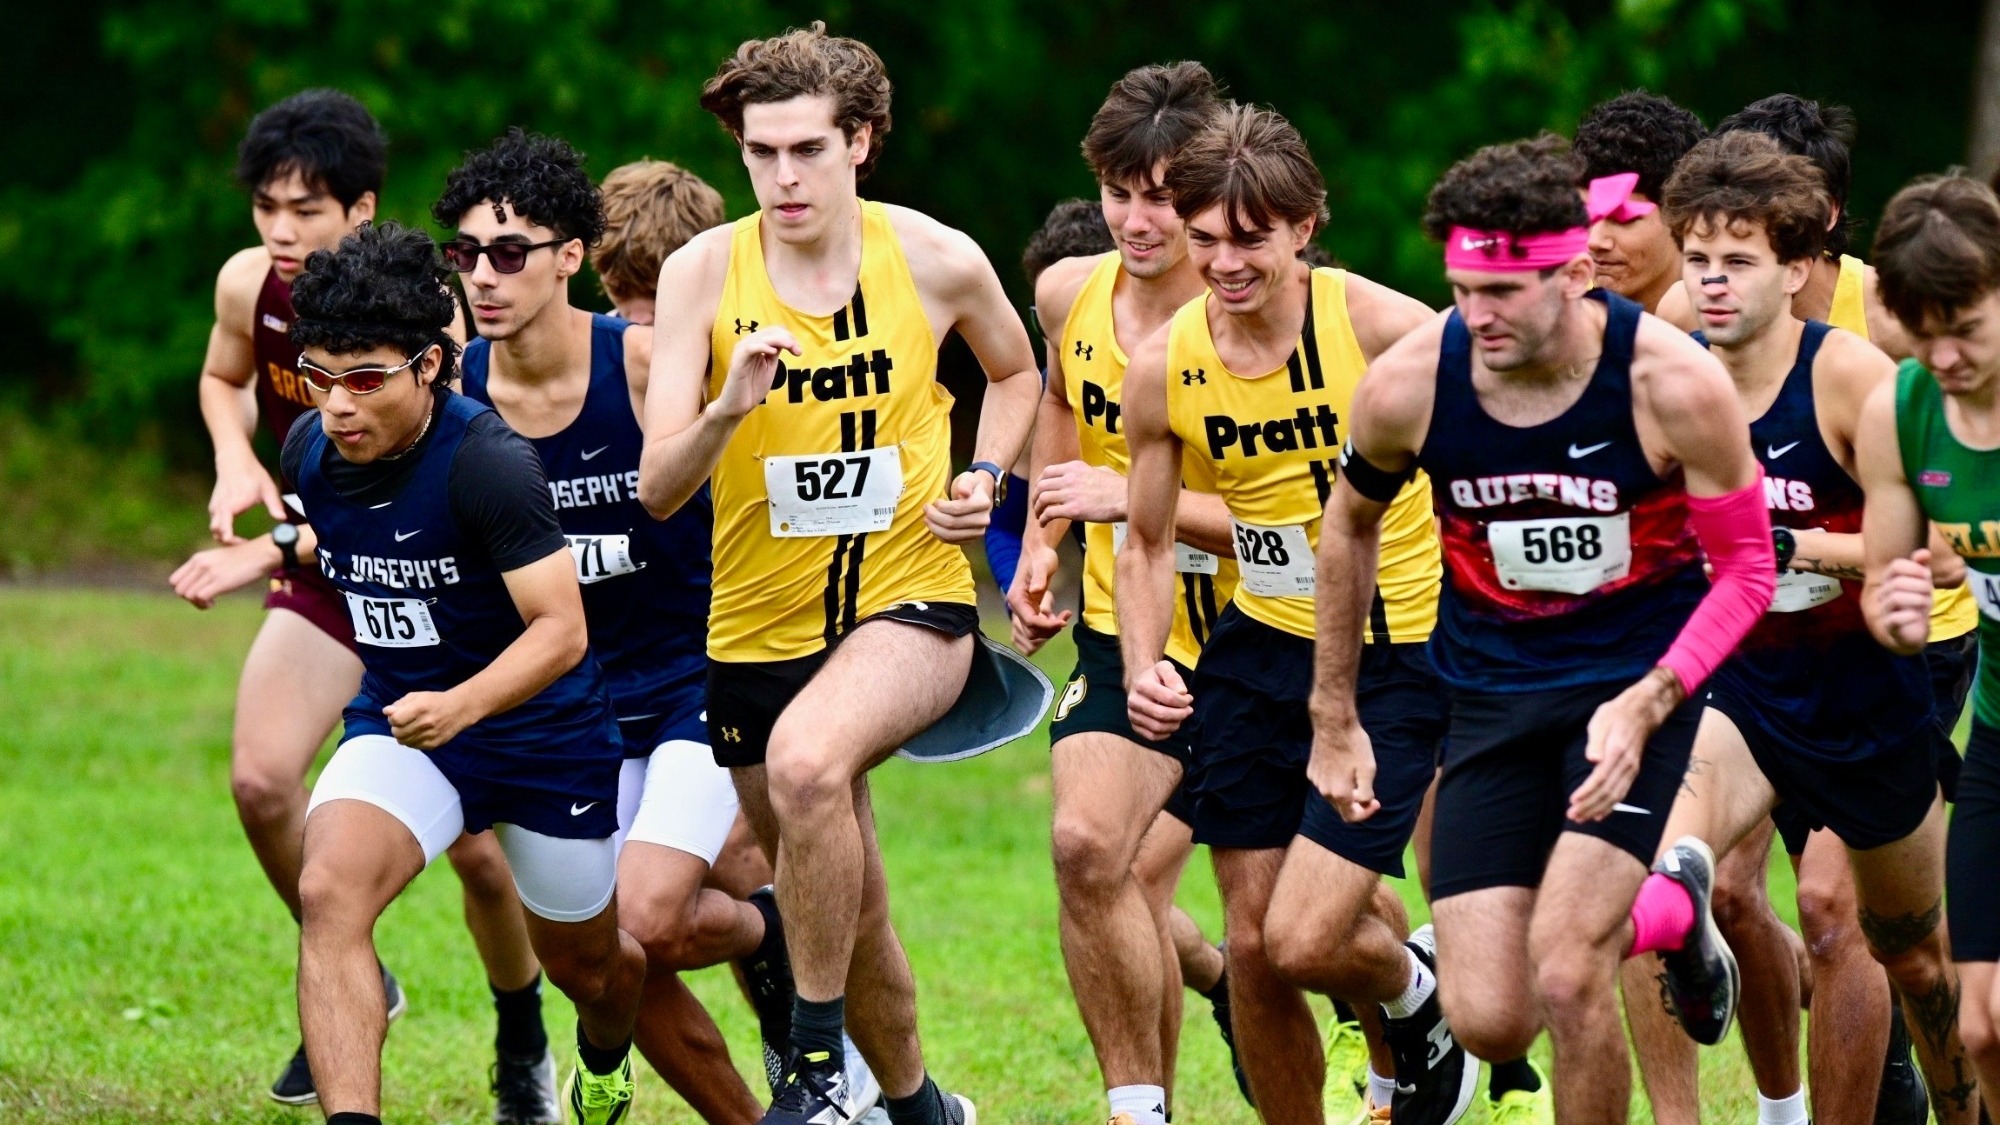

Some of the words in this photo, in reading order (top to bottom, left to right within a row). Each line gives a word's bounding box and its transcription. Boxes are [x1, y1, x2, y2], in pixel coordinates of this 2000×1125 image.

[1204, 404, 1339, 460] Pratt
[795, 456, 871, 501] 527
[1450, 473, 1618, 511] QUEENS
[565, 538, 611, 577] 71
[1235, 523, 1290, 567] 528
[1522, 524, 1603, 564] 568
[350, 555, 461, 589] JOSEPH'S
[363, 599, 415, 640] 675
[1052, 674, 1088, 722] P
